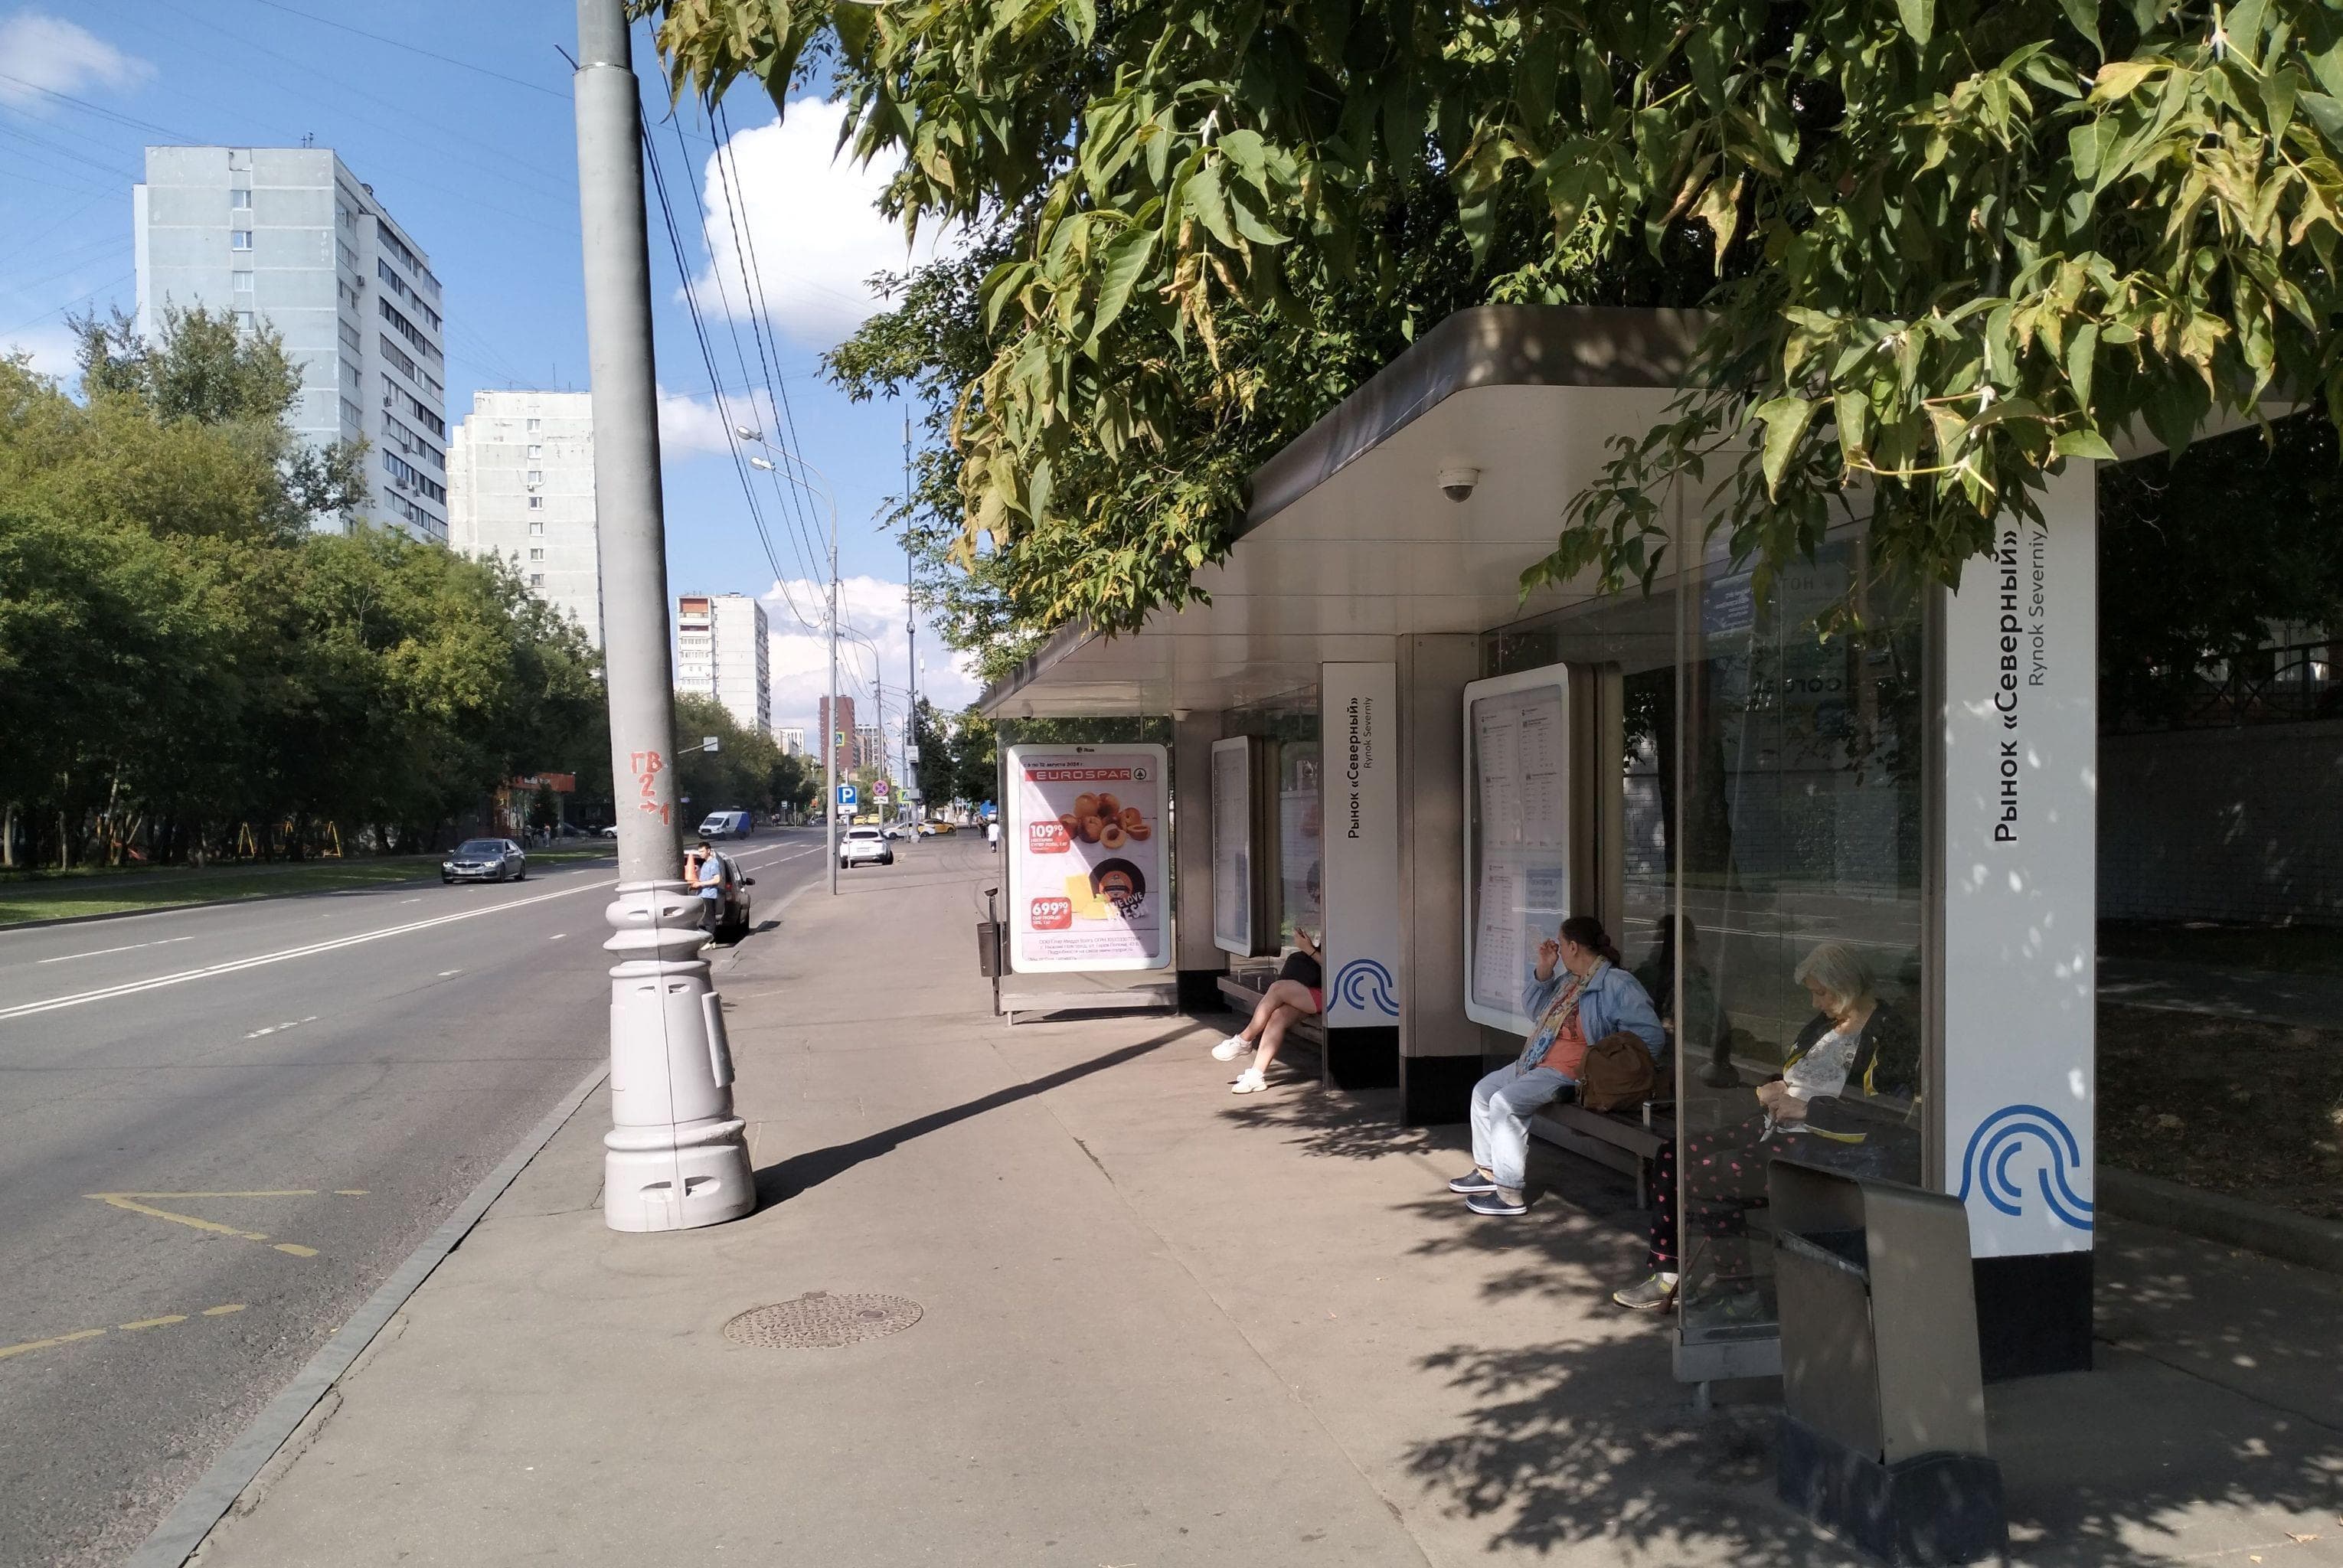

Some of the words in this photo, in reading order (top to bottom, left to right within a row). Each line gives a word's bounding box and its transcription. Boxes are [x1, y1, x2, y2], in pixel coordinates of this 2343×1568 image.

[2028, 530, 2048, 617] Severniy
[1994, 530, 2024, 730] «Северный»
[2028, 624, 2047, 686] Rynok
[1363, 697, 1373, 737] Severniy
[1347, 697, 1361, 788] «Северный»
[1363, 740, 1374, 769] Rynok
[639, 773, 655, 797] 2
[843, 788, 854, 803] P
[1036, 770, 1131, 780] EUROSPAR
[1995, 740, 2018, 841] Рынок
[1348, 792, 1360, 838] Рынок
[1122, 891, 1145, 906] LOVE
